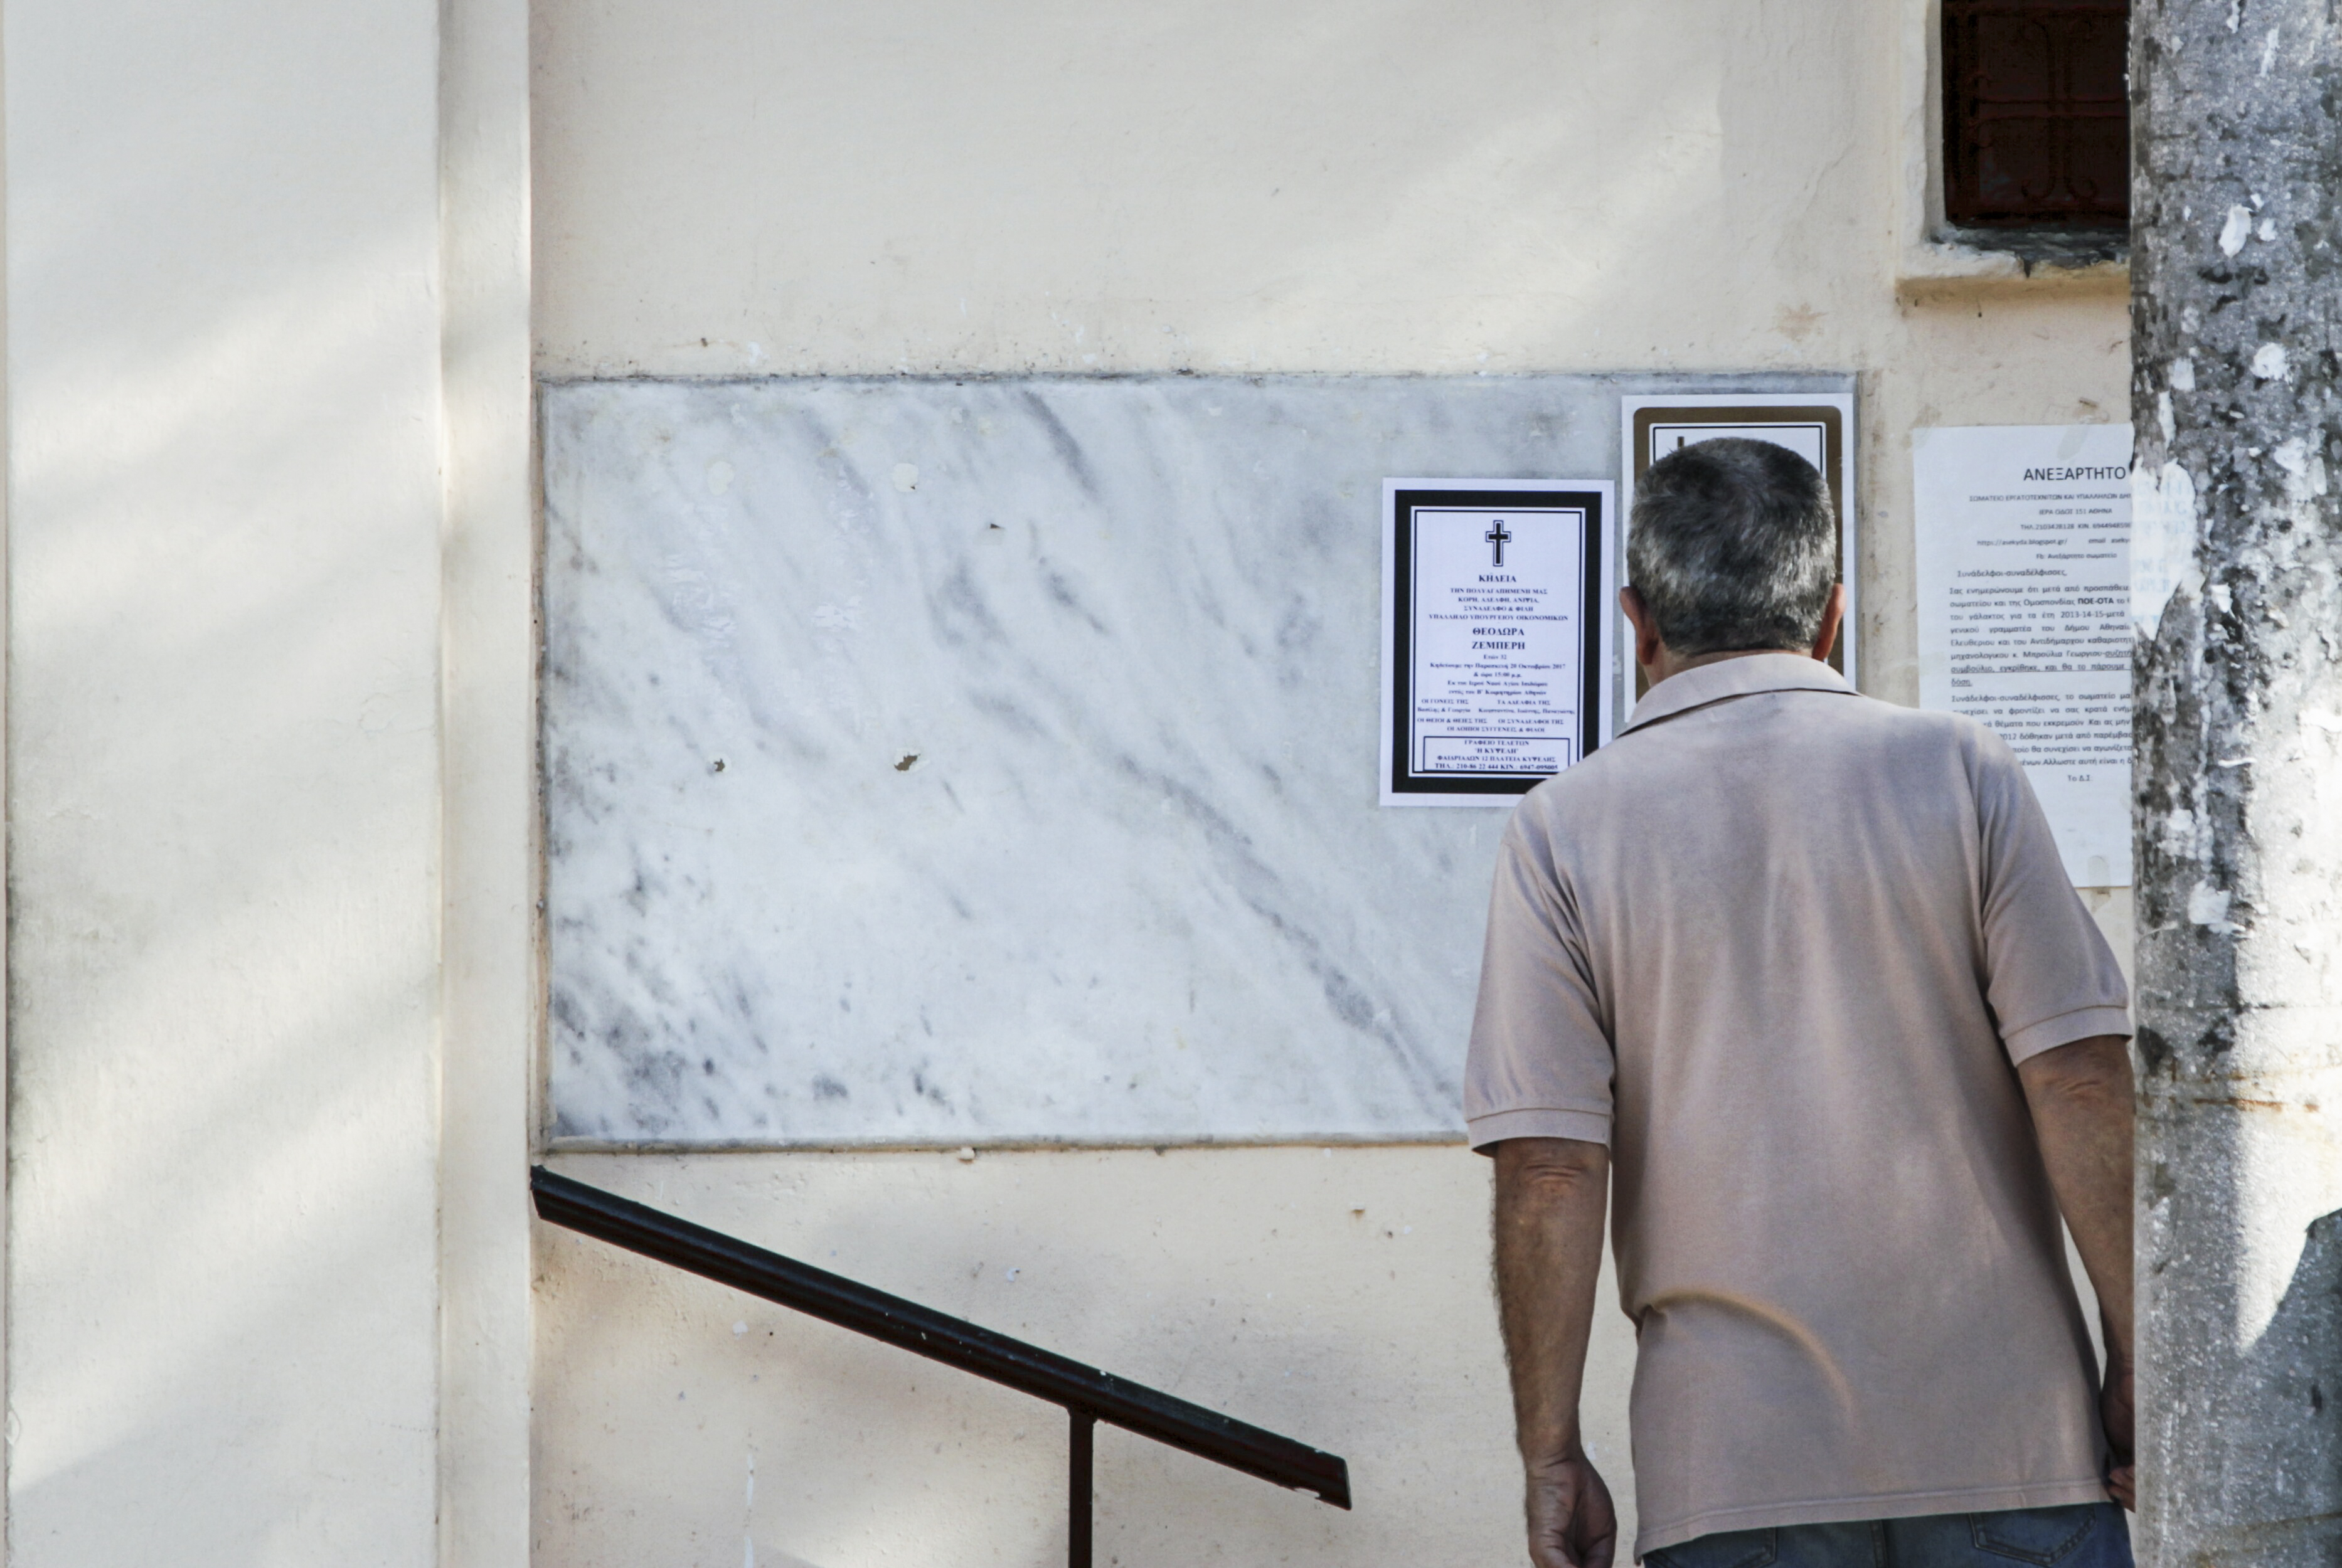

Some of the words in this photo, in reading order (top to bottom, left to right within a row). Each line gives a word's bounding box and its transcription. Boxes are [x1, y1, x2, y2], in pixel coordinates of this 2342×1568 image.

[2023, 467, 2126, 480] ΑΝΕΞΑΡΤΗΤΟ
[1949, 587, 1963, 595] Σας
[1966, 587, 2023, 595] ενημερώνουμε
[2042, 585, 2060, 593] μετά
[1950, 600, 1992, 608] σωματείου
[2023, 598, 2075, 607] Ομοσπονδίας
[1950, 626, 1979, 634] γενικού
[2064, 624, 2090, 632] Δήμου
[2030, 637, 2084, 645] Αντιδήμαρχου
[2061, 663, 2073, 671] θα
[2090, 663, 2126, 671] πάρουμε
[2079, 692, 2116, 701] σωματείο
[2009, 707, 2045, 715] φροντίζει
[2084, 706, 2107, 714] κρατά
[1994, 720, 2023, 728] θέματα
[2055, 733, 2073, 741] μετά
